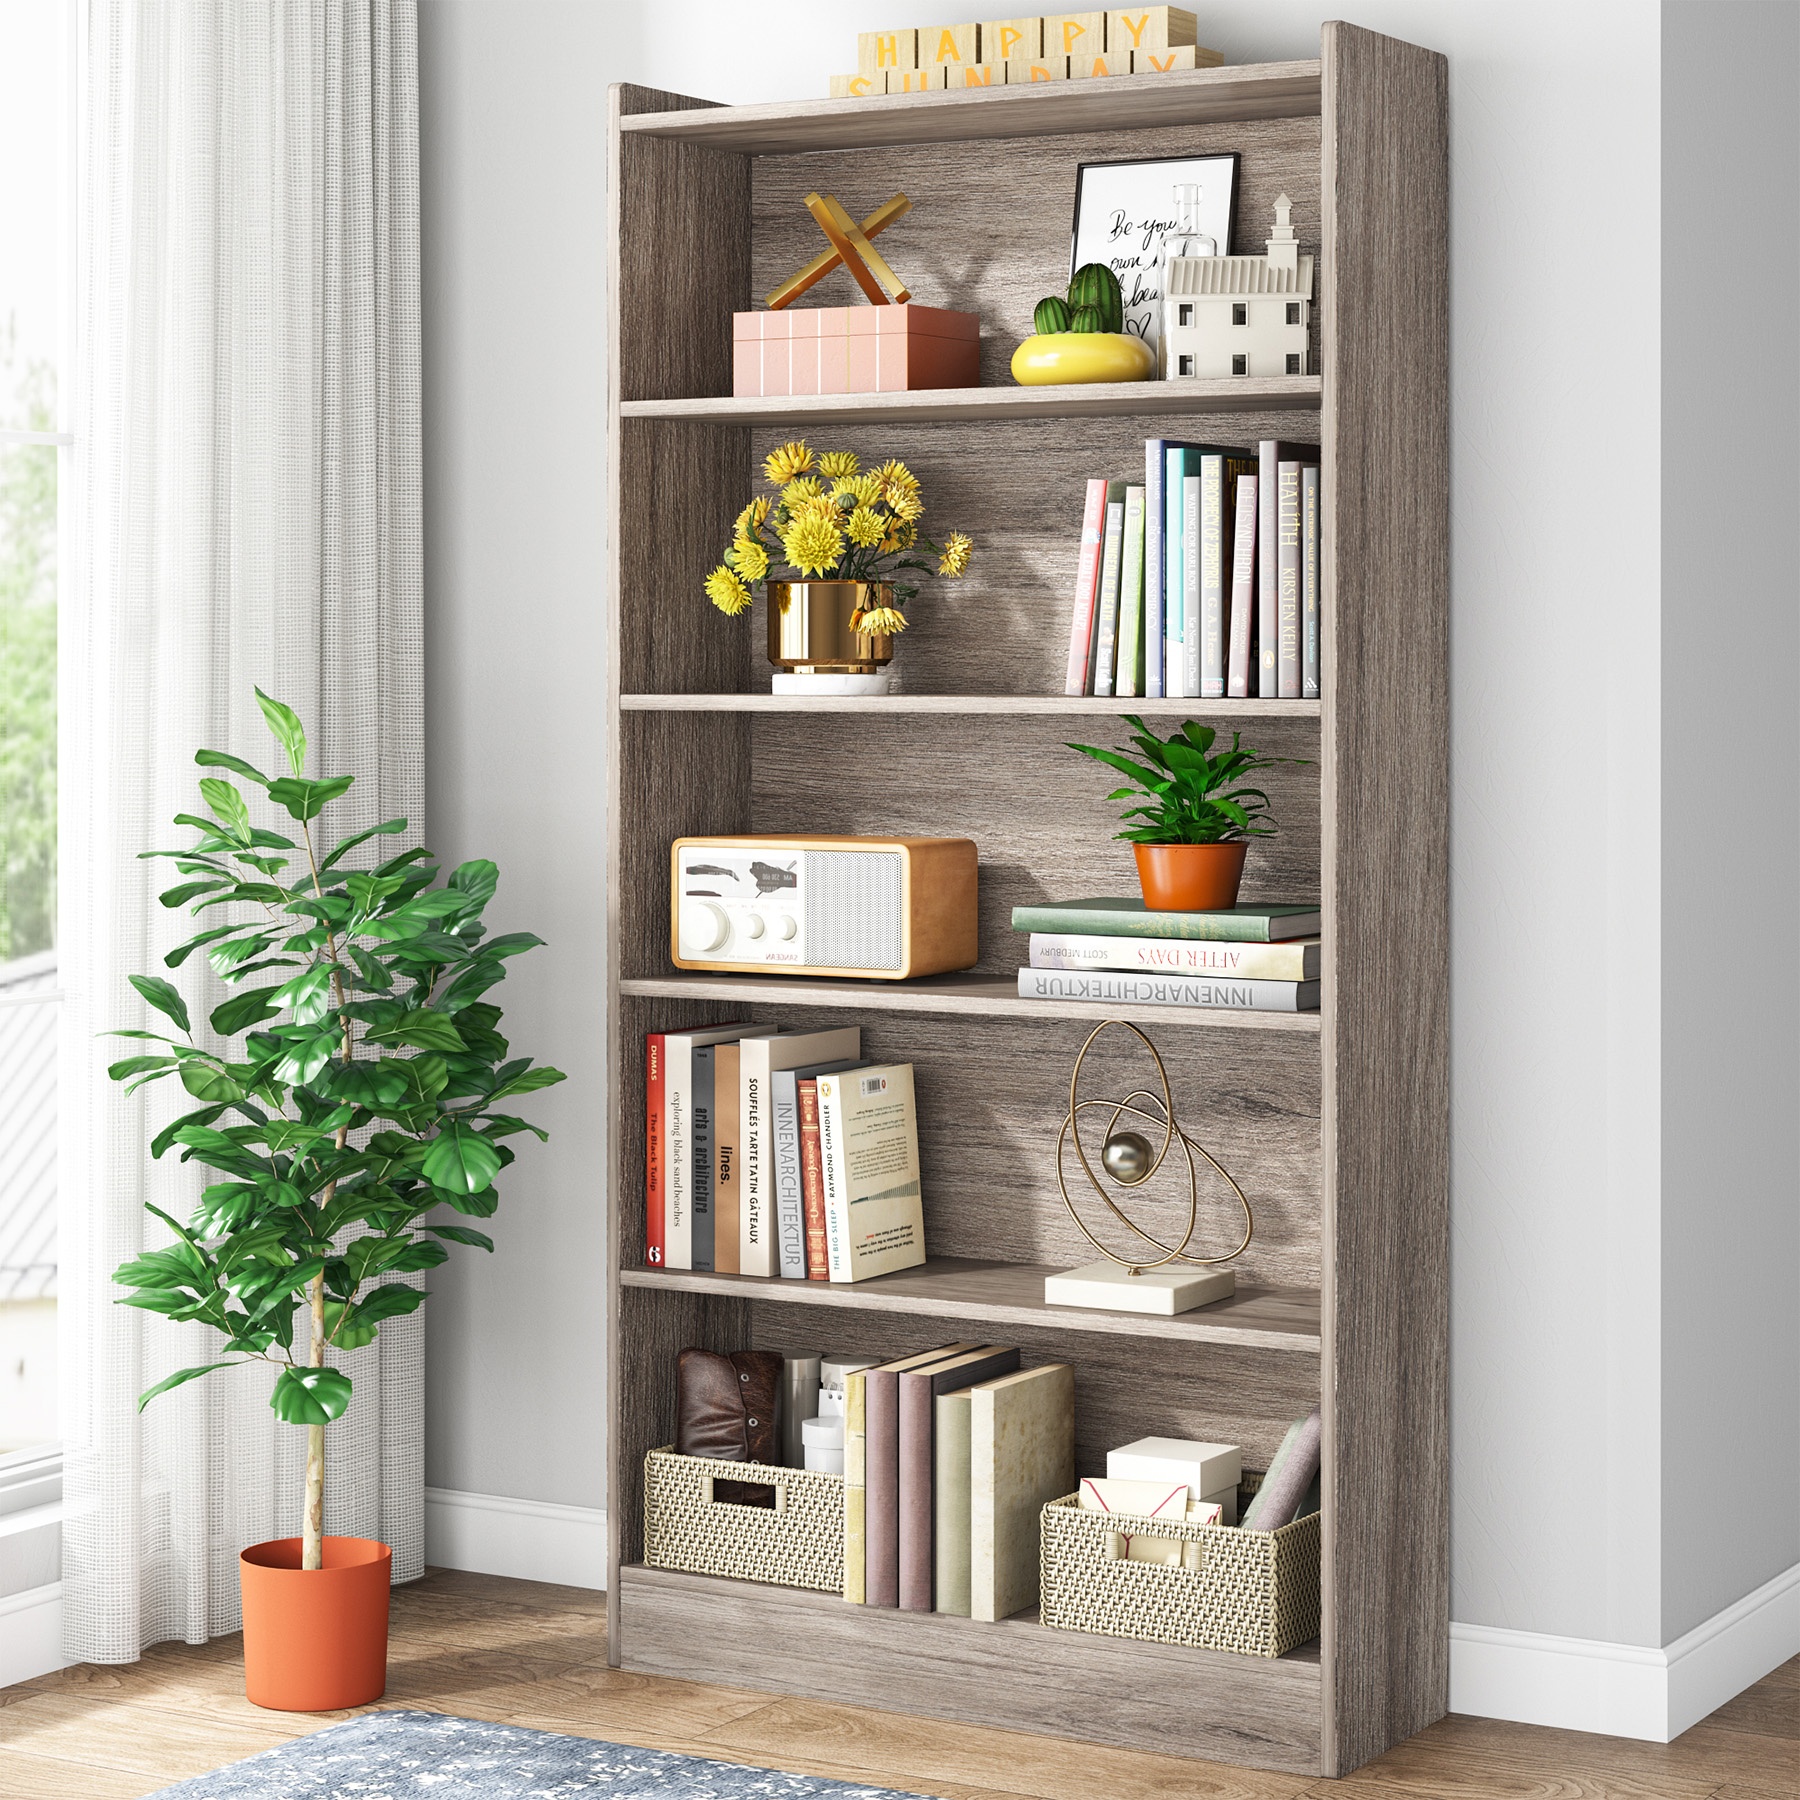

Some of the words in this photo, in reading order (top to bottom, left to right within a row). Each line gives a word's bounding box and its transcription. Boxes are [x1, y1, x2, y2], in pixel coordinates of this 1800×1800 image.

[877, 14, 1150, 68] HAPPY
[1108, 209, 1133, 243] Be
[1137, 219, 1178, 251] you
[1204, 459, 1220, 478] THE
[1204, 478, 1220, 526] PROPHECY
[1308, 486, 1315, 496] ON
[1188, 493, 1196, 530] WAITING
[1148, 516, 1158, 563] CROWN
[1188, 531, 1196, 548] FOR
[1204, 528, 1220, 541] OF
[1234, 486, 1255, 584] GEOSYNCHRON
[1105, 535, 1119, 577] DUNGEON
[1188, 548, 1196, 569] KARL
[1204, 542, 1220, 588] ZEPHYRUS
[1308, 564, 1315, 572] OF
[1104, 578, 1116, 590] OF
[1188, 570, 1196, 592] ROVE
[1282, 568, 1296, 622] KIRSTEN
[1102, 592, 1115, 622] DEATH
[1146, 565, 1158, 632] CONSPIRACY
[1207, 596, 1218, 612] G.
[1207, 614, 1218, 628] A.
[1240, 608, 1248, 630] DAVID
[1207, 630, 1218, 666] Hesse
[1239, 631, 1247, 654] LOUIS
[1282, 625, 1296, 662] KELLY
[1188, 667, 1196, 688] Decker
[1039, 946, 1080, 958] MEDBURY
[1083, 948, 1108, 960] SCOTT
[1137, 948, 1180, 967] DAYS
[1187, 950, 1240, 968] AFTER
[1035, 976, 1254, 1006] INNENARCHITEKTUR
[671, 1092, 683, 1136] exploring
[749, 1078, 761, 1127] SOUFFLÉS
[696, 1108, 710, 1129] arts
[823, 1104, 832, 1150] CHANDLER
[674, 1139, 682, 1164] black
[749, 1130, 758, 1162] TARTE
[674, 1166, 682, 1188] sand
[696, 1147, 710, 1214] architecture
[720, 1146, 733, 1186] lines.
[749, 1164, 758, 1194] TATIN
[826, 1154, 836, 1198] RAYMOND
[777, 1102, 800, 1266] INNENARCHITEKTUR
[674, 1189, 682, 1228] beaches
[749, 1197, 761, 1245] GÂTEAUX
[830, 1210, 838, 1234] SLEEP
